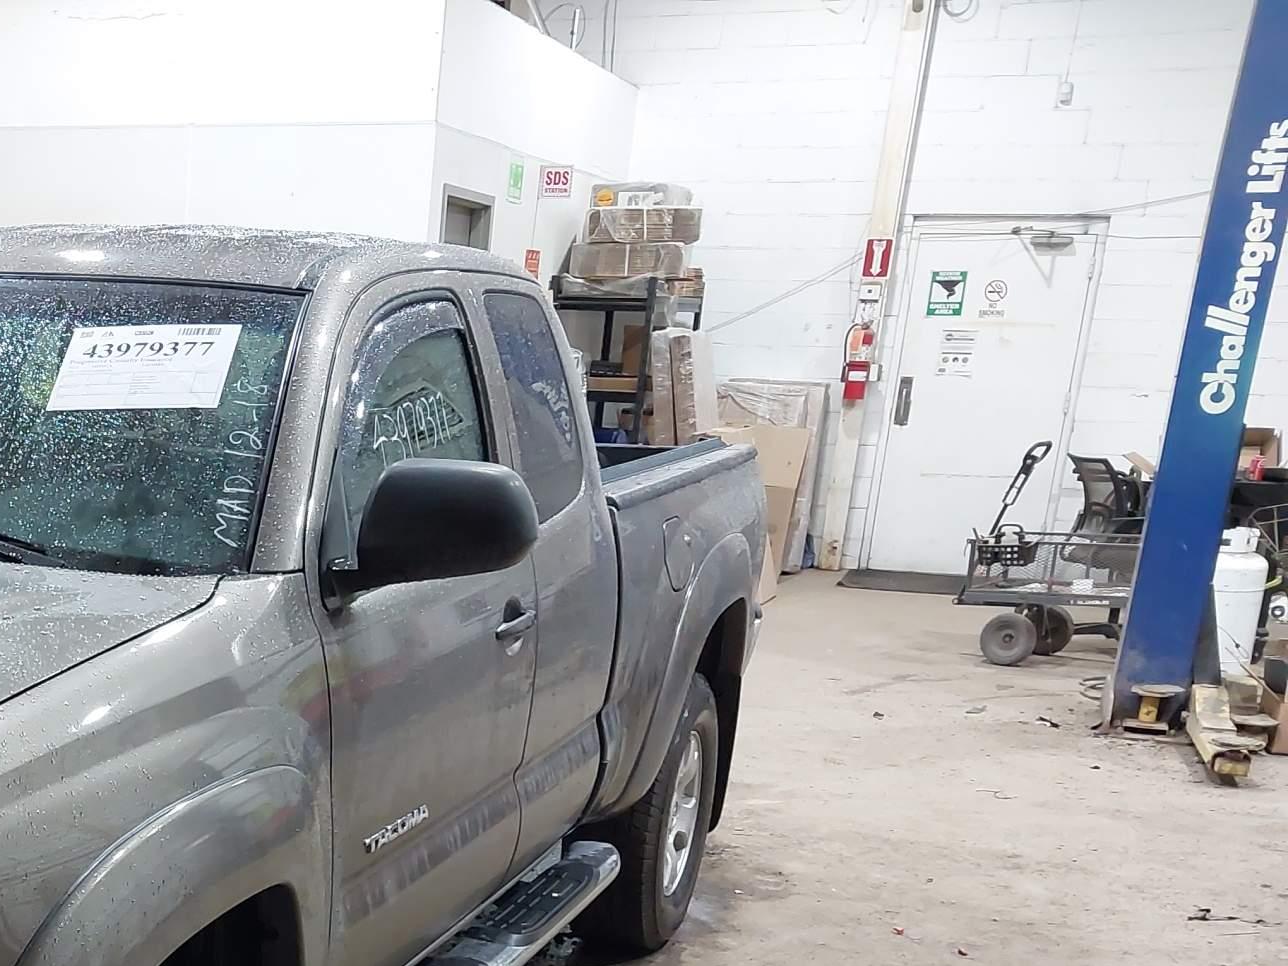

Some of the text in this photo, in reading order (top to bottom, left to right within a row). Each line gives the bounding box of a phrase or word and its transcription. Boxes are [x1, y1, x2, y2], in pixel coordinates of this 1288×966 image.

[545, 170, 570, 187] SDS
[1199, 119, 1288, 415] Challenger Lifts
[82, 341, 215, 359] 43979377
[363, 804, 429, 853] TACOMA
